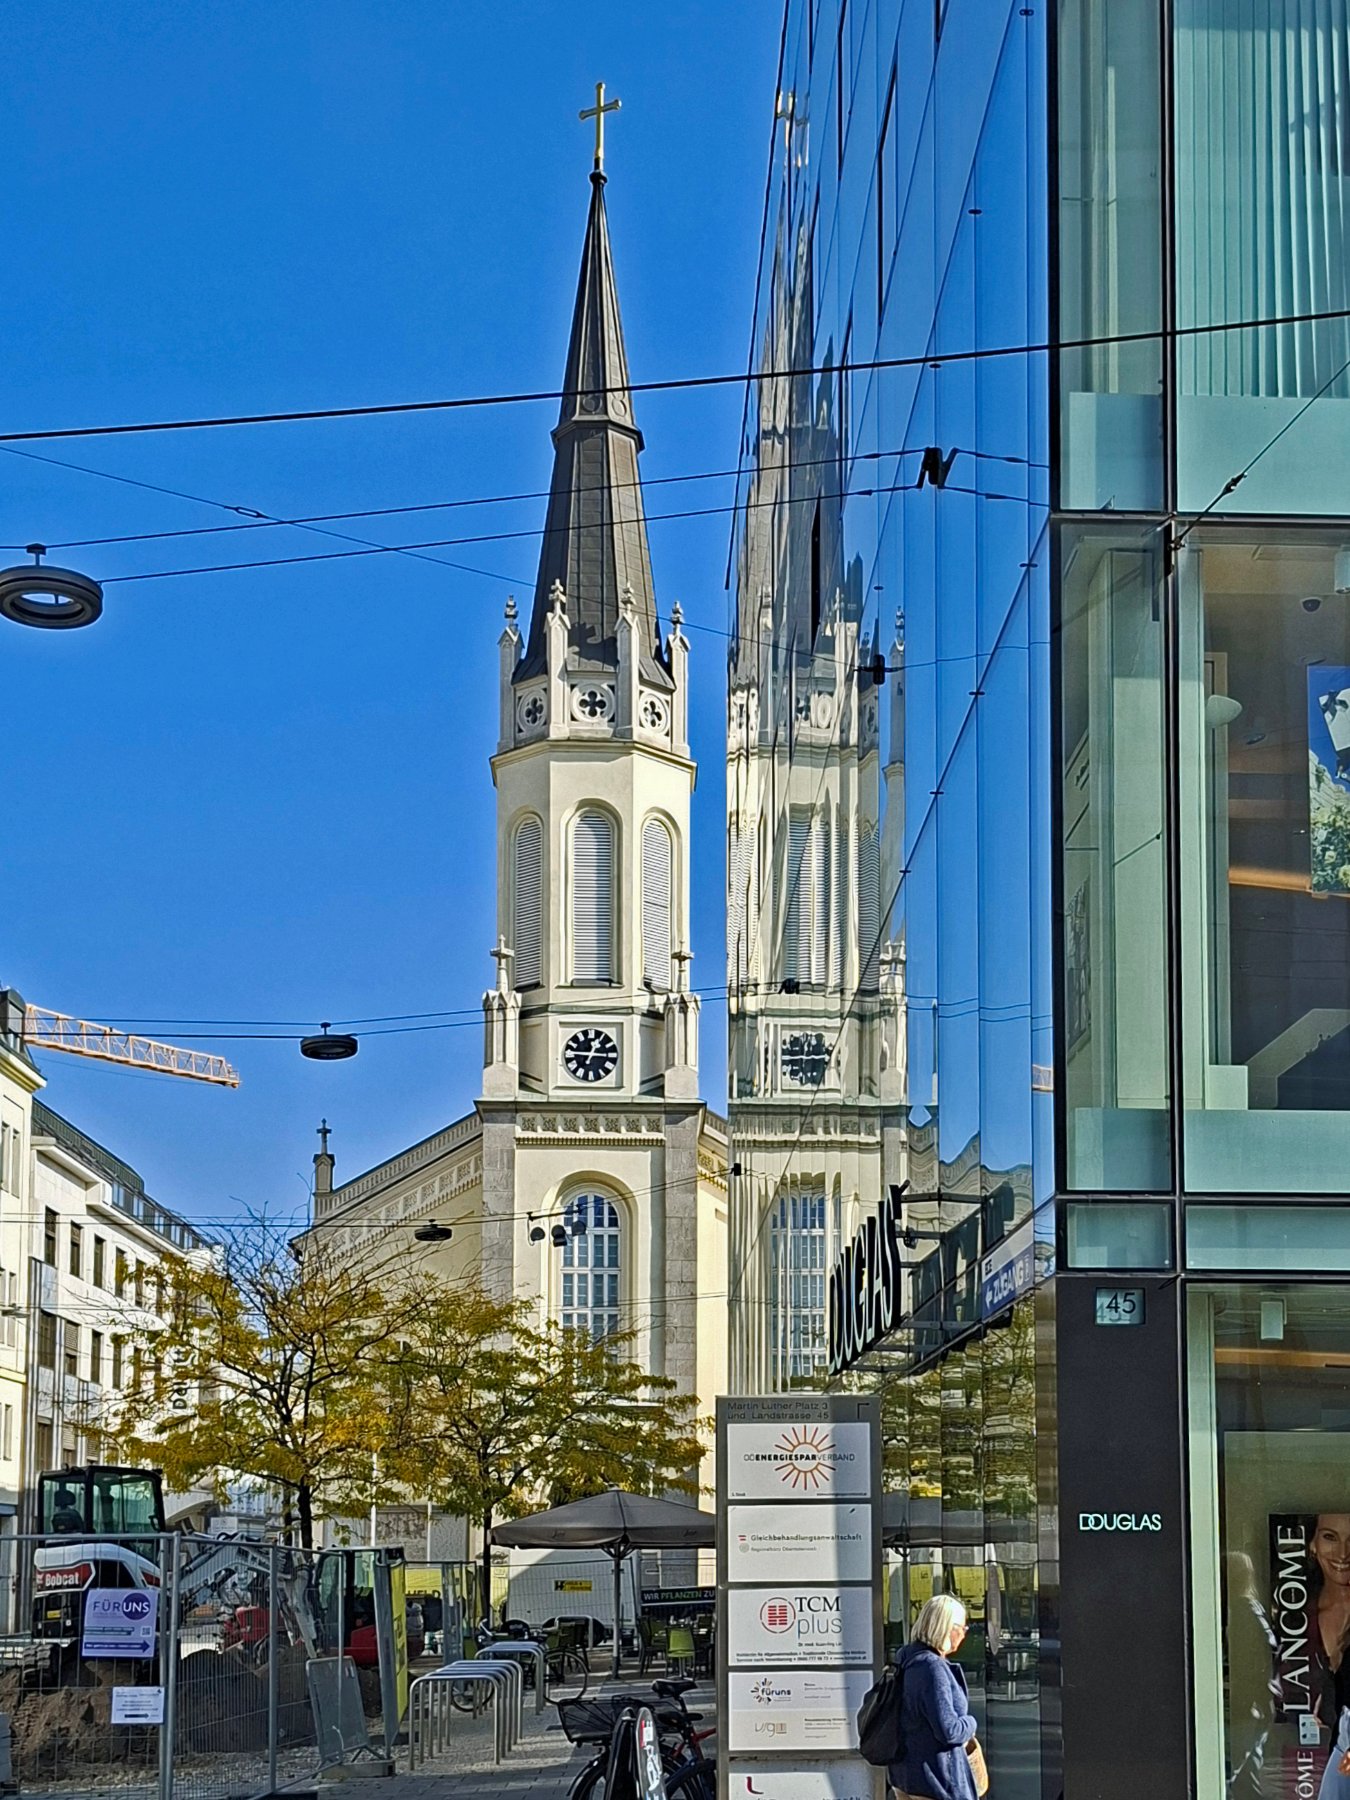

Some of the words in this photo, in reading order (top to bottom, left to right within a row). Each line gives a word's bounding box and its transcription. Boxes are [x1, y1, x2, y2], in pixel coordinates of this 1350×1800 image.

[1105, 1292, 1136, 1314] 45
[727, 1402, 759, 1410] Martin
[761, 1402, 792, 1410] Luther
[795, 1402, 819, 1410] Platz
[821, 1402, 828, 1410] 3
[1079, 1513, 1162, 1531] DOUGLAS
[45, 1572, 79, 1587] Bobcat
[644, 1592, 660, 1600] WIR
[661, 1589, 701, 1600] PFLANZEN
[795, 1596, 841, 1612] TCM
[798, 1614, 842, 1639] plus
[1273, 1525, 1311, 1713] LANCÔME
[761, 1688, 791, 1696] füruns
[1295, 1751, 1314, 1800] ÔME
